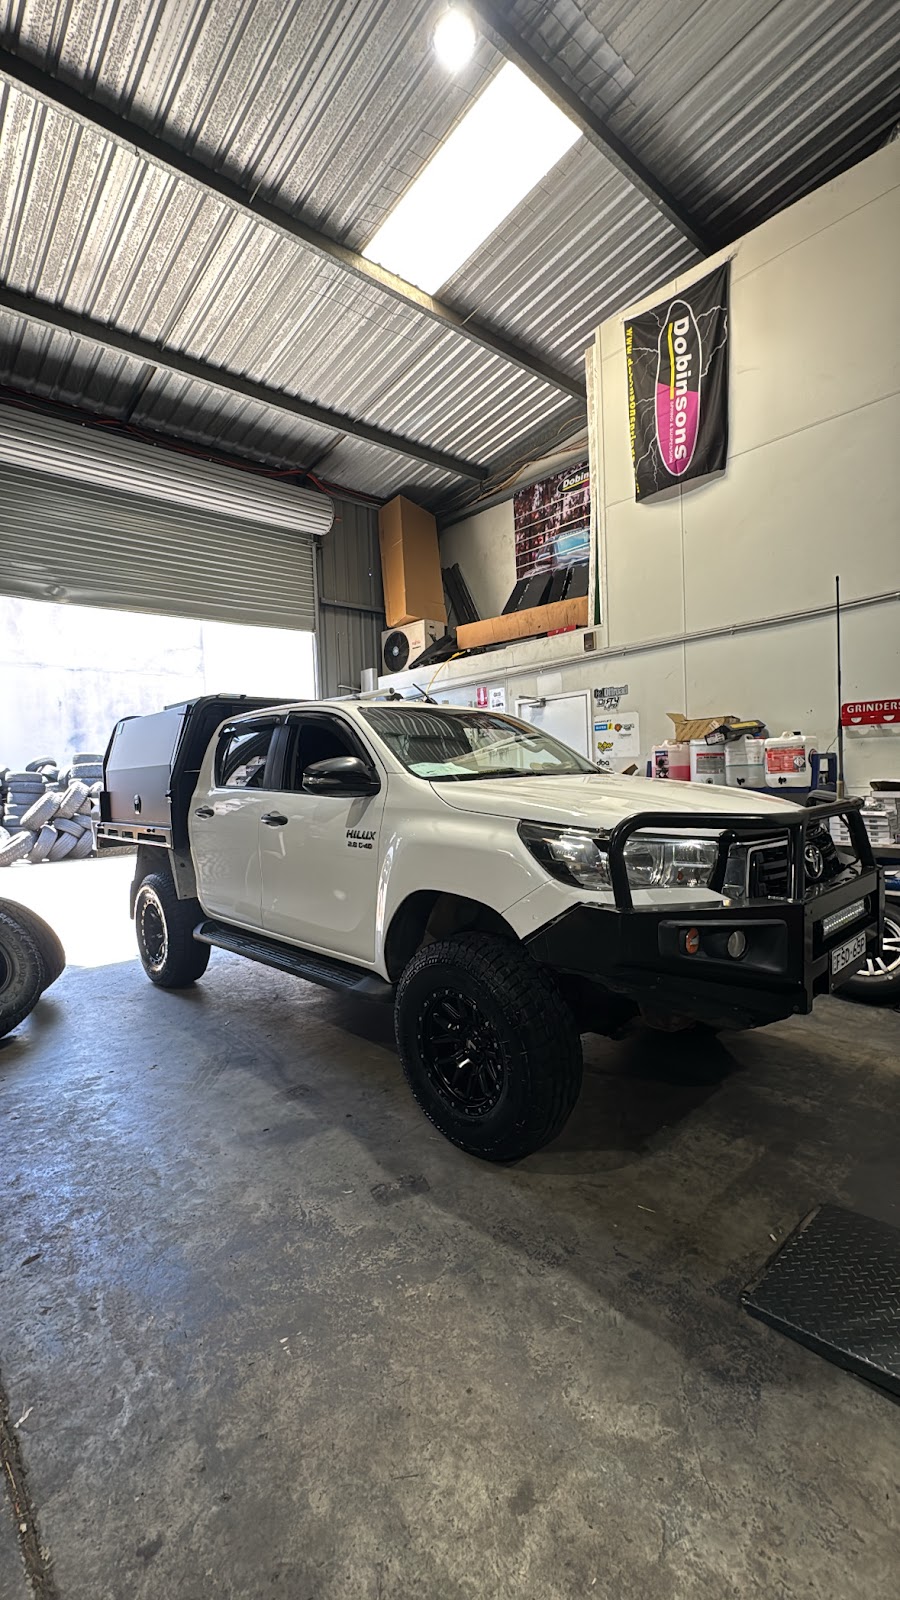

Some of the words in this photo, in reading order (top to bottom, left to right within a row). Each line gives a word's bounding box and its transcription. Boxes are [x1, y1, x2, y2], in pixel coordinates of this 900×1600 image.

[673, 316, 692, 460] Dobinsons
[563, 472, 590, 487] Dobin
[346, 830, 376, 840] HILUX
